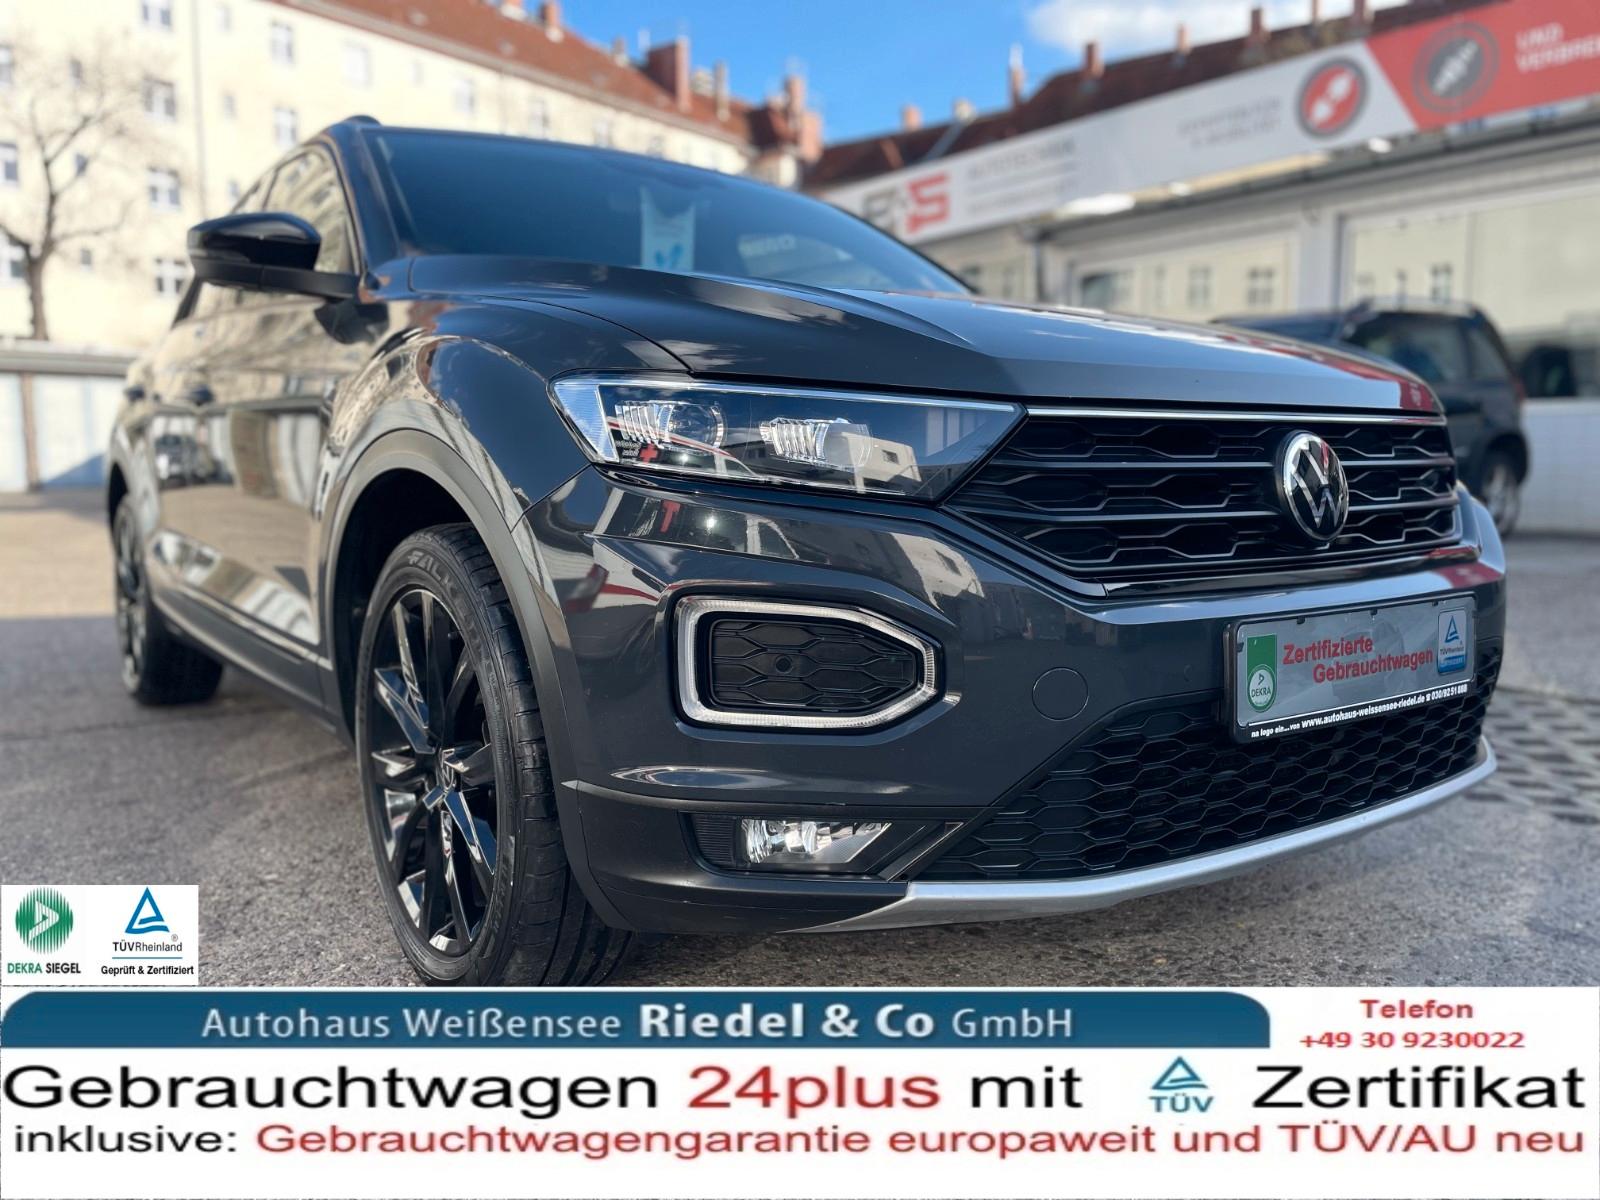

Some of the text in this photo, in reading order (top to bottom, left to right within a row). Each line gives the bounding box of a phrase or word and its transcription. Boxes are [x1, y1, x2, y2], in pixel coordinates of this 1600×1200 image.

[1283, 635, 1374, 665] Zertifizierte
[1313, 648, 1434, 683] Gebrauchtwagen
[1251, 686, 1272, 698] DEKRA
[1260, 728, 1274, 737] logo
